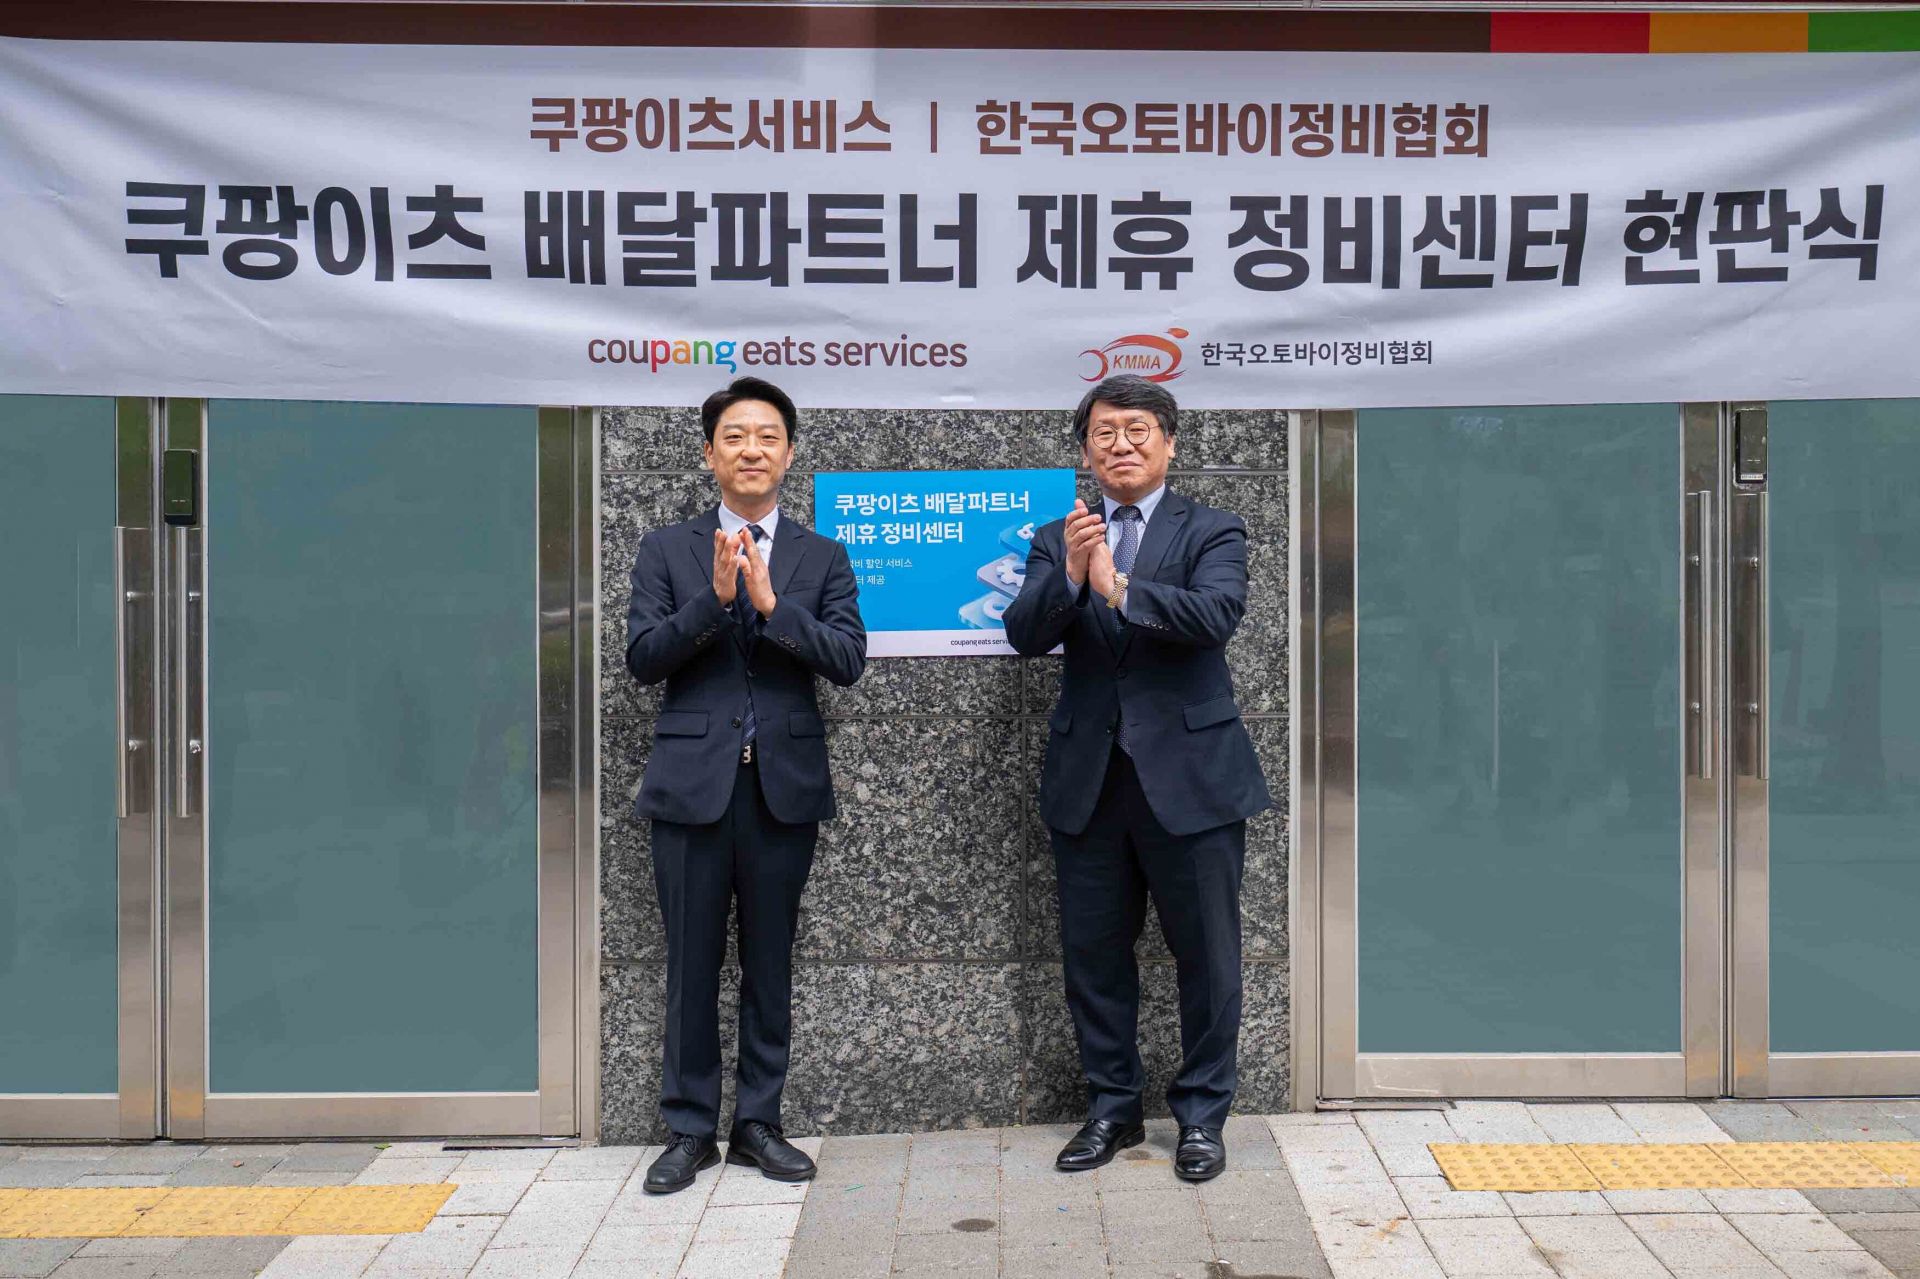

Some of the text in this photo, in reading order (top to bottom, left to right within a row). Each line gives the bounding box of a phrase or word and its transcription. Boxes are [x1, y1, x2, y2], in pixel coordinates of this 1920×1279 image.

[531, 97, 1489, 158] 쿠팡이츠서비스 한국오토바이정비협회
[125, 181, 1885, 292] 쿠팡이츠 배달파트너 제휴 정비센터 현판식
[588, 333, 968, 374] coupang eats services
[1113, 354, 1161, 369] KMMA
[1200, 340, 1432, 366] 한국오토바이정비협회
[834, 490, 1030, 516] 쿠팡이츠 배달파트너
[834, 521, 963, 545] 제휴 정비센터
[866, 558, 883, 569] 할인
[886, 558, 913, 568] 서비스
[867, 575, 885, 585] 제공
